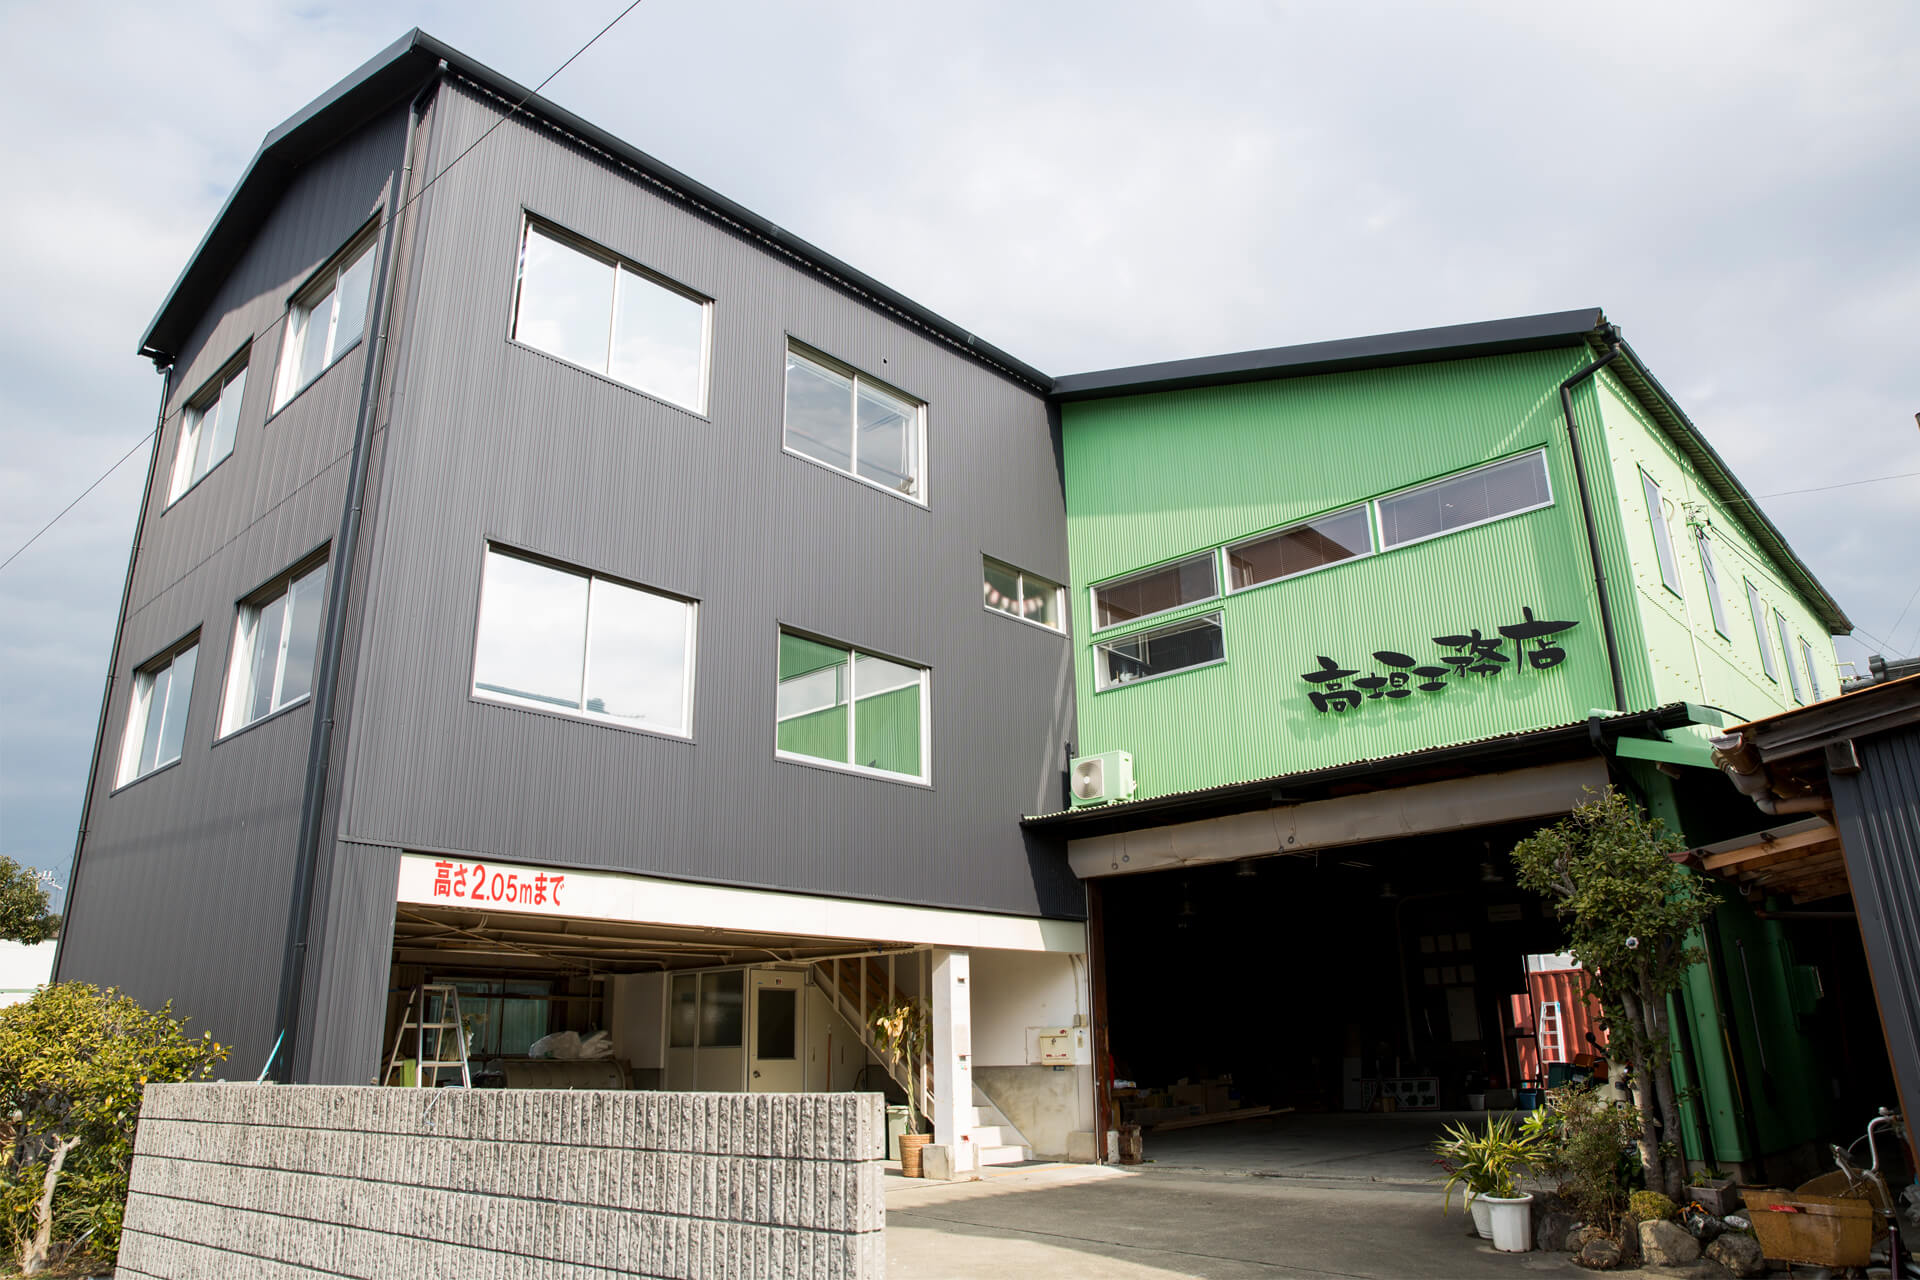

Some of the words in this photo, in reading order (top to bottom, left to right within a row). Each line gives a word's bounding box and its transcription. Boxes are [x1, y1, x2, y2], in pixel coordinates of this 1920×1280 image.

[1301, 606, 1580, 713] 高垣工務店
[434, 860, 564, 906] 高さ2.05mまで
